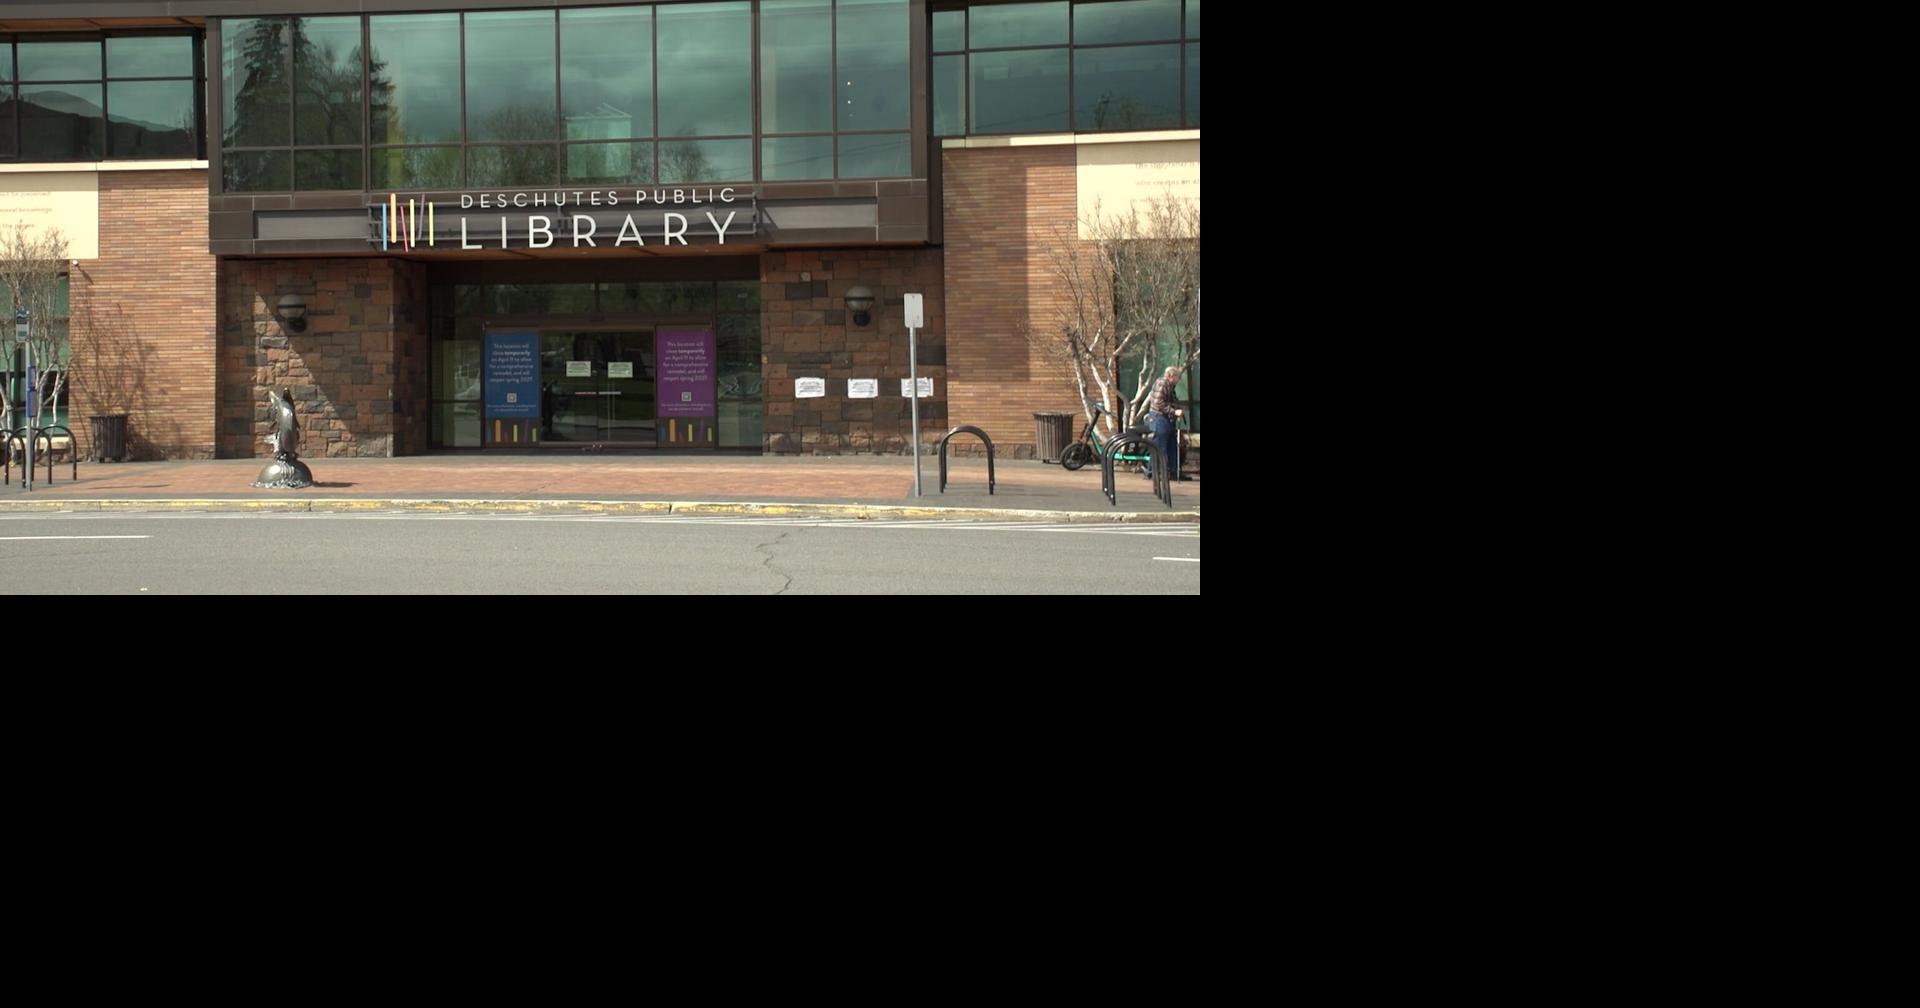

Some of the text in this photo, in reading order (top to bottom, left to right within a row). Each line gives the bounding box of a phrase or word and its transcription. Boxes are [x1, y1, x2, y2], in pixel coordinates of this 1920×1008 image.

[460, 187, 736, 209] DESCHUTES PUBLIC
[461, 211, 737, 250] LIBRARY
